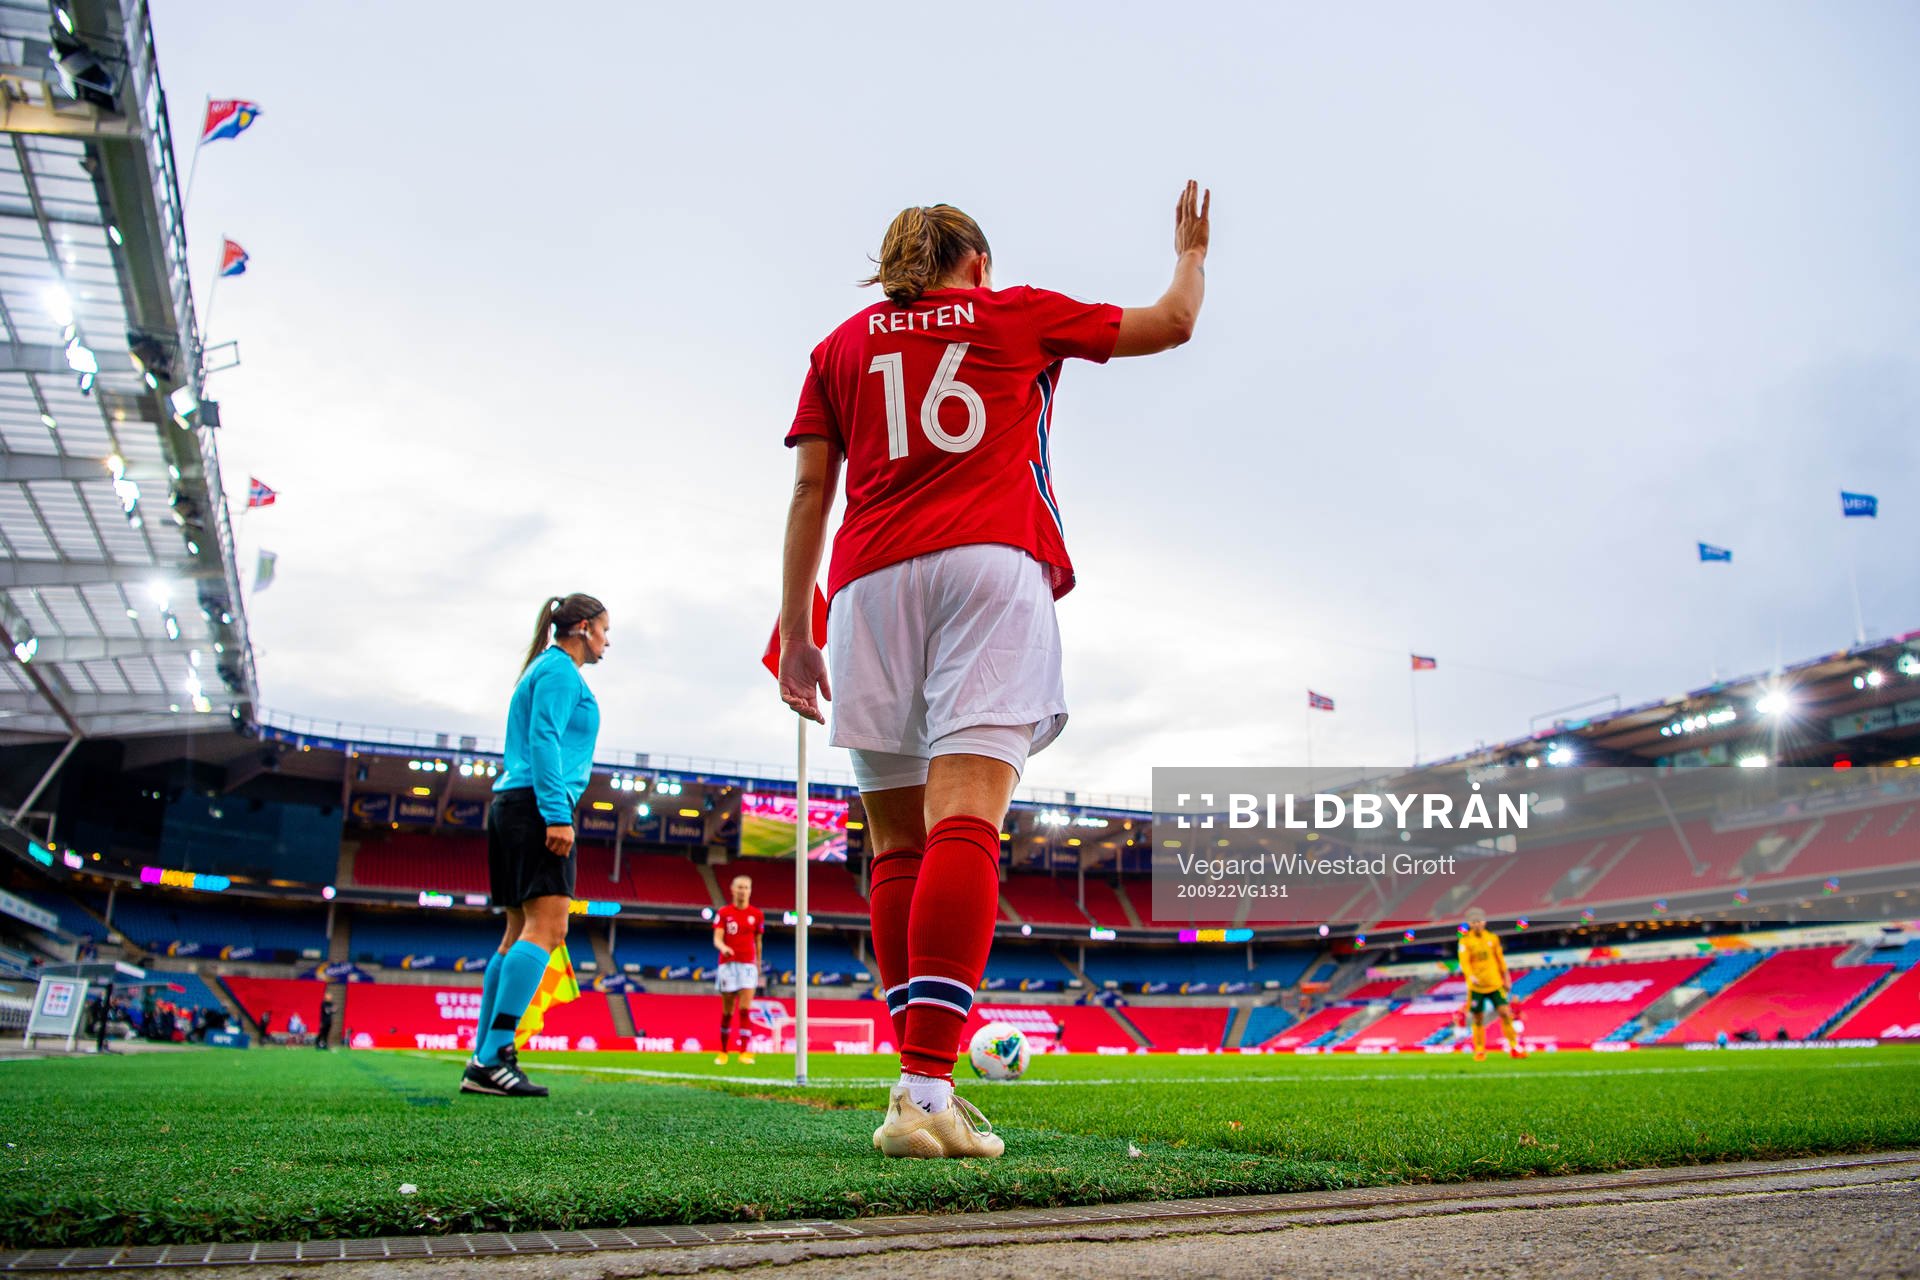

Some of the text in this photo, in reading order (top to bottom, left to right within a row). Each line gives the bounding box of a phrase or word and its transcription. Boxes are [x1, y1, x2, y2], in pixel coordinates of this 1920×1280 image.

[868, 302, 975, 335] REITEN
[868, 342, 987, 460] 16
[414, 1034, 458, 1050] TINE
